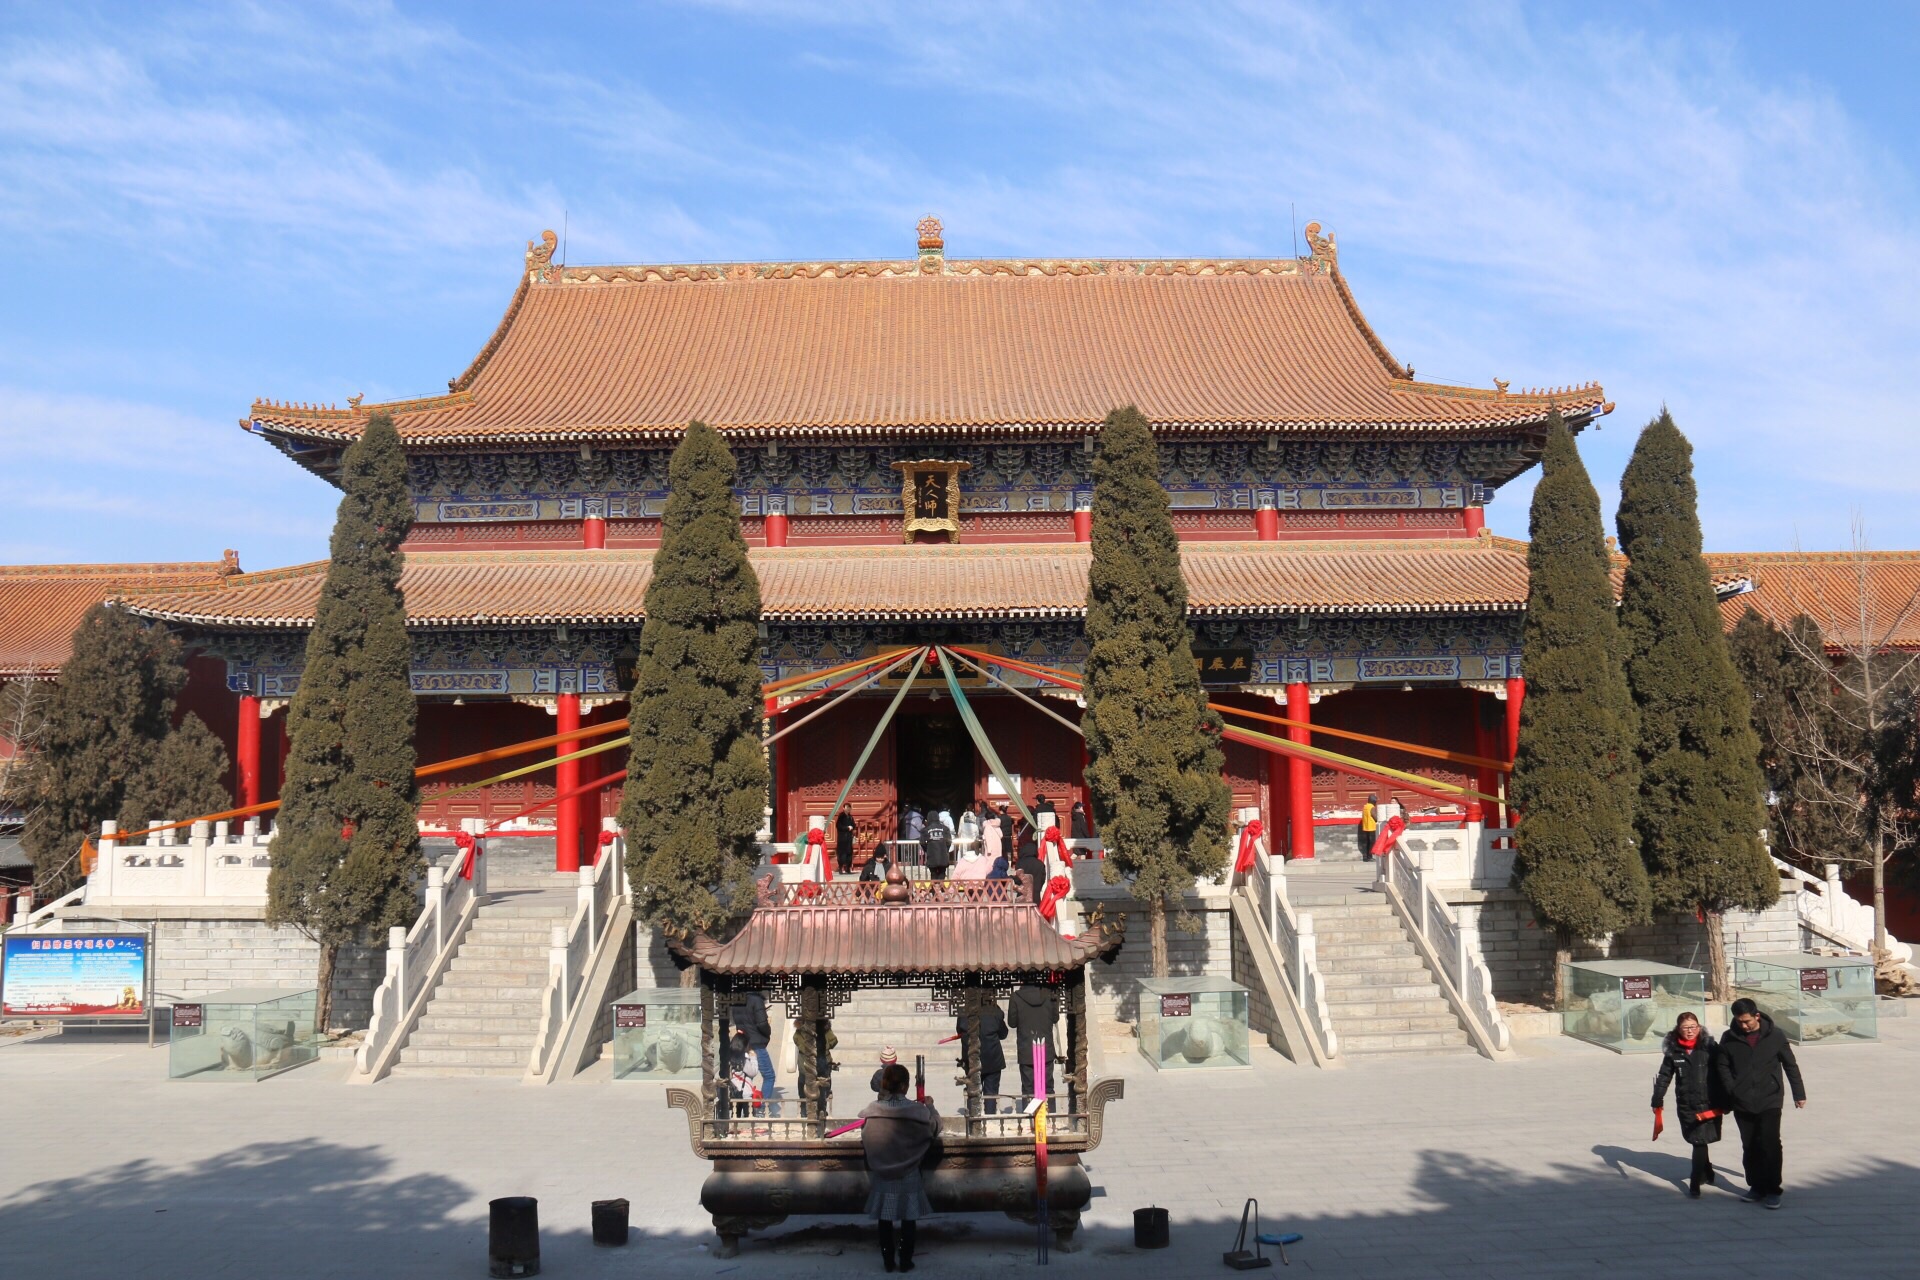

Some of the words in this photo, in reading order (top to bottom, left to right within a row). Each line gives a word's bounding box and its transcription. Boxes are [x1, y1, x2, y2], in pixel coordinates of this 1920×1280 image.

[925, 475, 940, 516] 天人師
[31, 940, 114, 949] 扫黑除恶专项斗争
